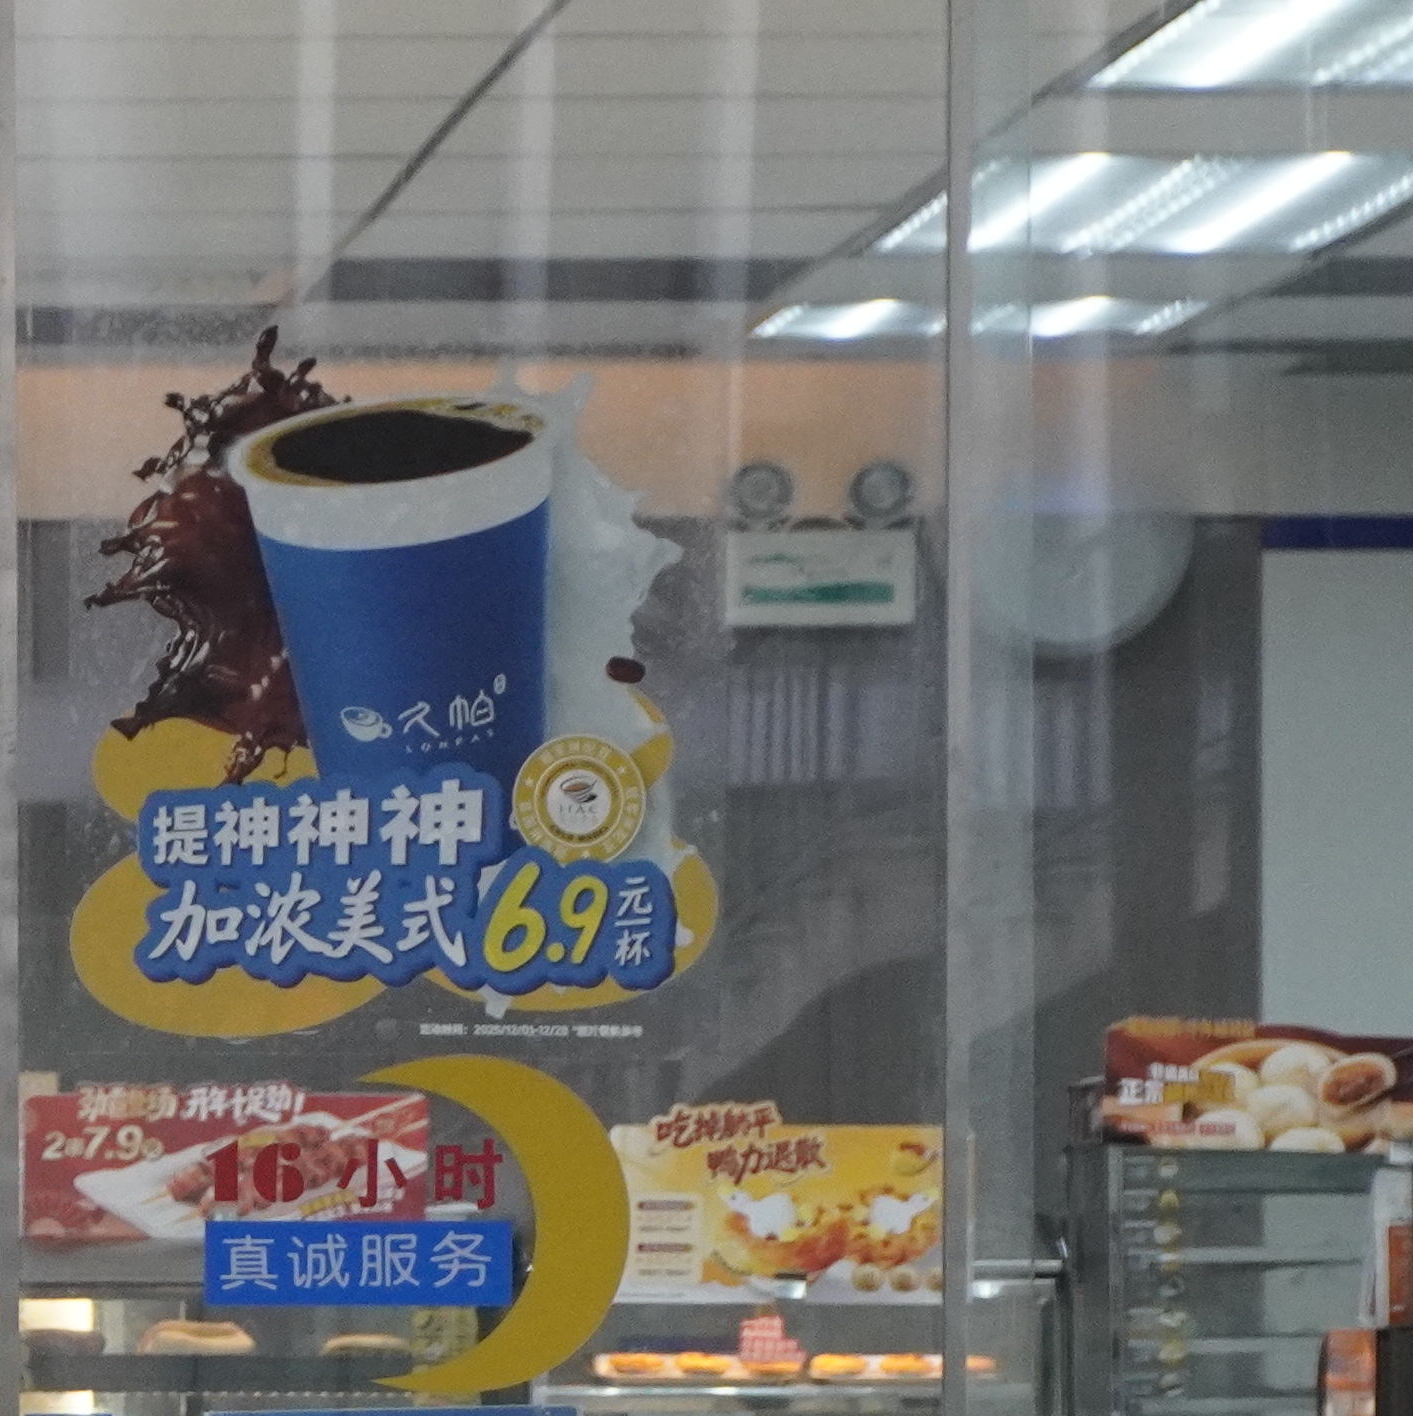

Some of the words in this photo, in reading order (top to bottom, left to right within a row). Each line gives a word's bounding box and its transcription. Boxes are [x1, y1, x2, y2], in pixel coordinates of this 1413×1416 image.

[153, 780, 483, 866] 提神神神
[147, 871, 466, 967] 加浓美式
[482, 862, 608, 972] 6.9
[206, 1142, 304, 1203] 16
[221, 1231, 491, 1291] 真诚服务
